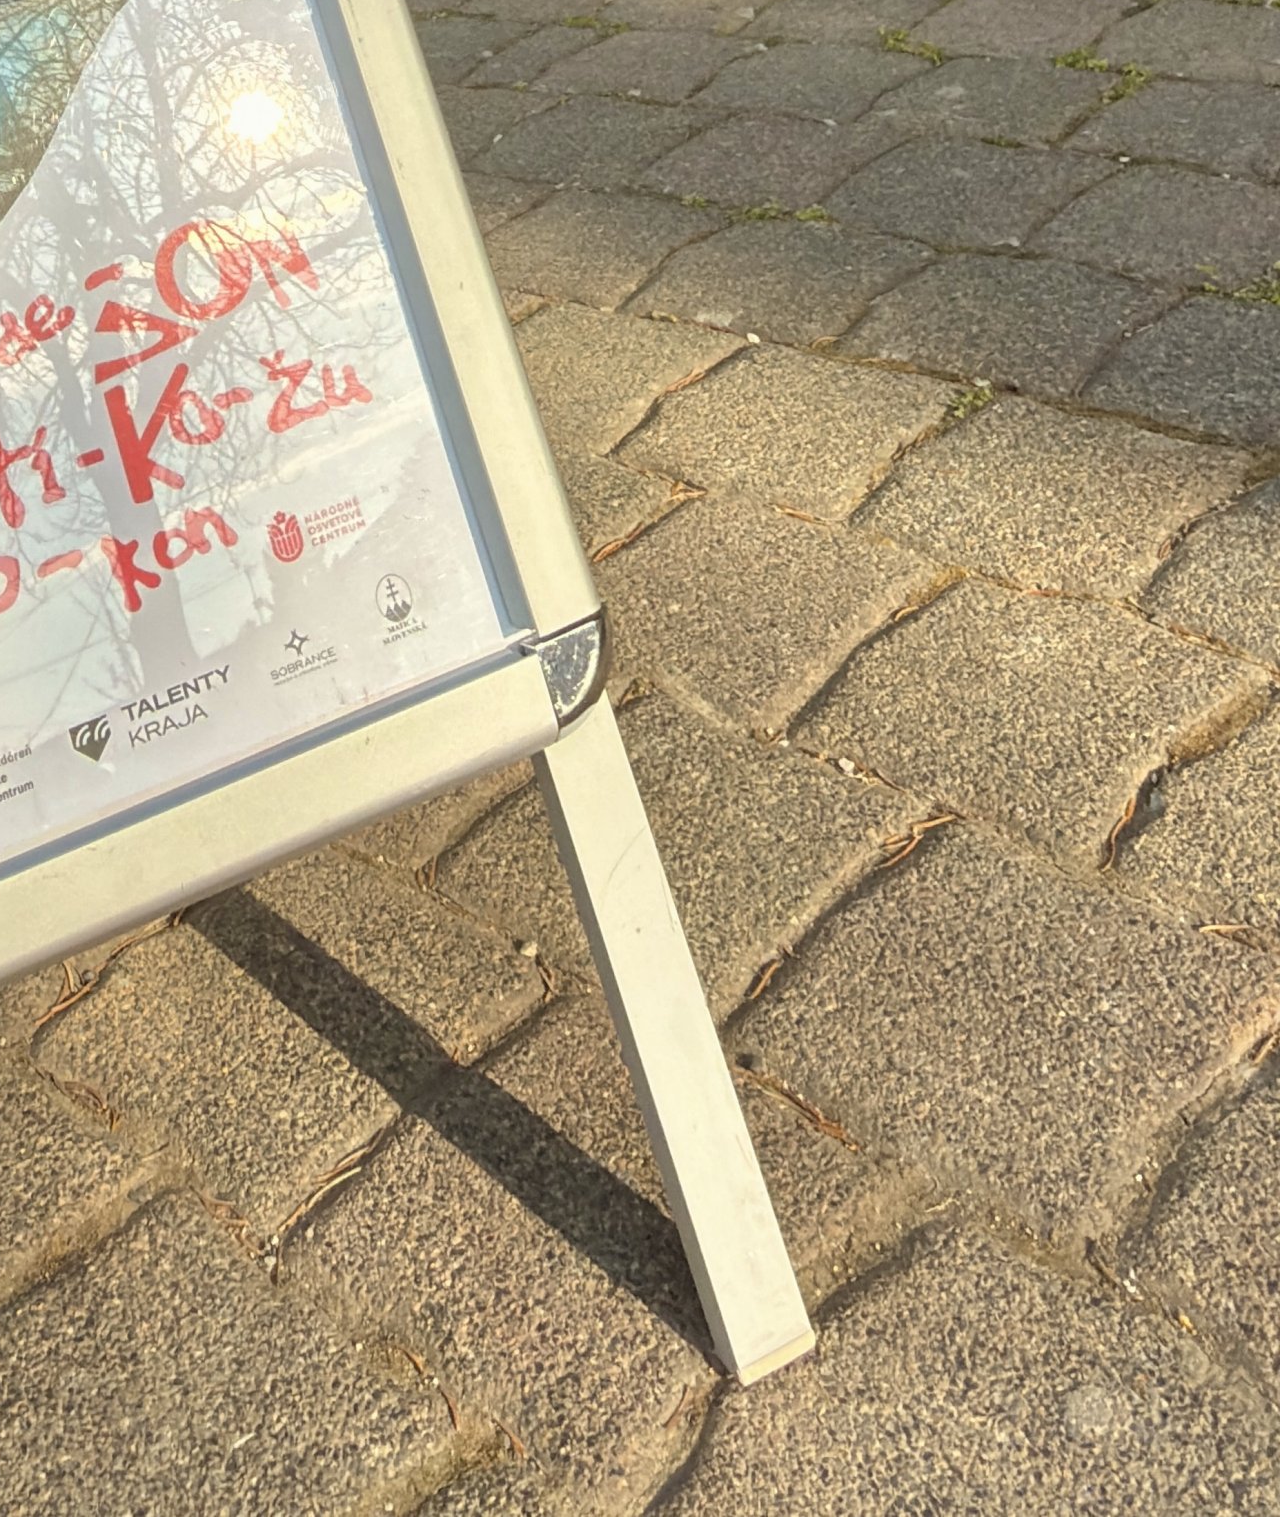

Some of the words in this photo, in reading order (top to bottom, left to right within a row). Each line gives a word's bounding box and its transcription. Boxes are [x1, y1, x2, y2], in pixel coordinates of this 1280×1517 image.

[303, 495, 361, 525] NÁRODNÉ
[307, 507, 364, 536] OSVETOVÉ
[311, 519, 367, 548] CENTRUM
[270, 646, 337, 681] SOBRANCE
[120, 665, 231, 723] TALENTY
[127, 703, 210, 750] KRAJA
